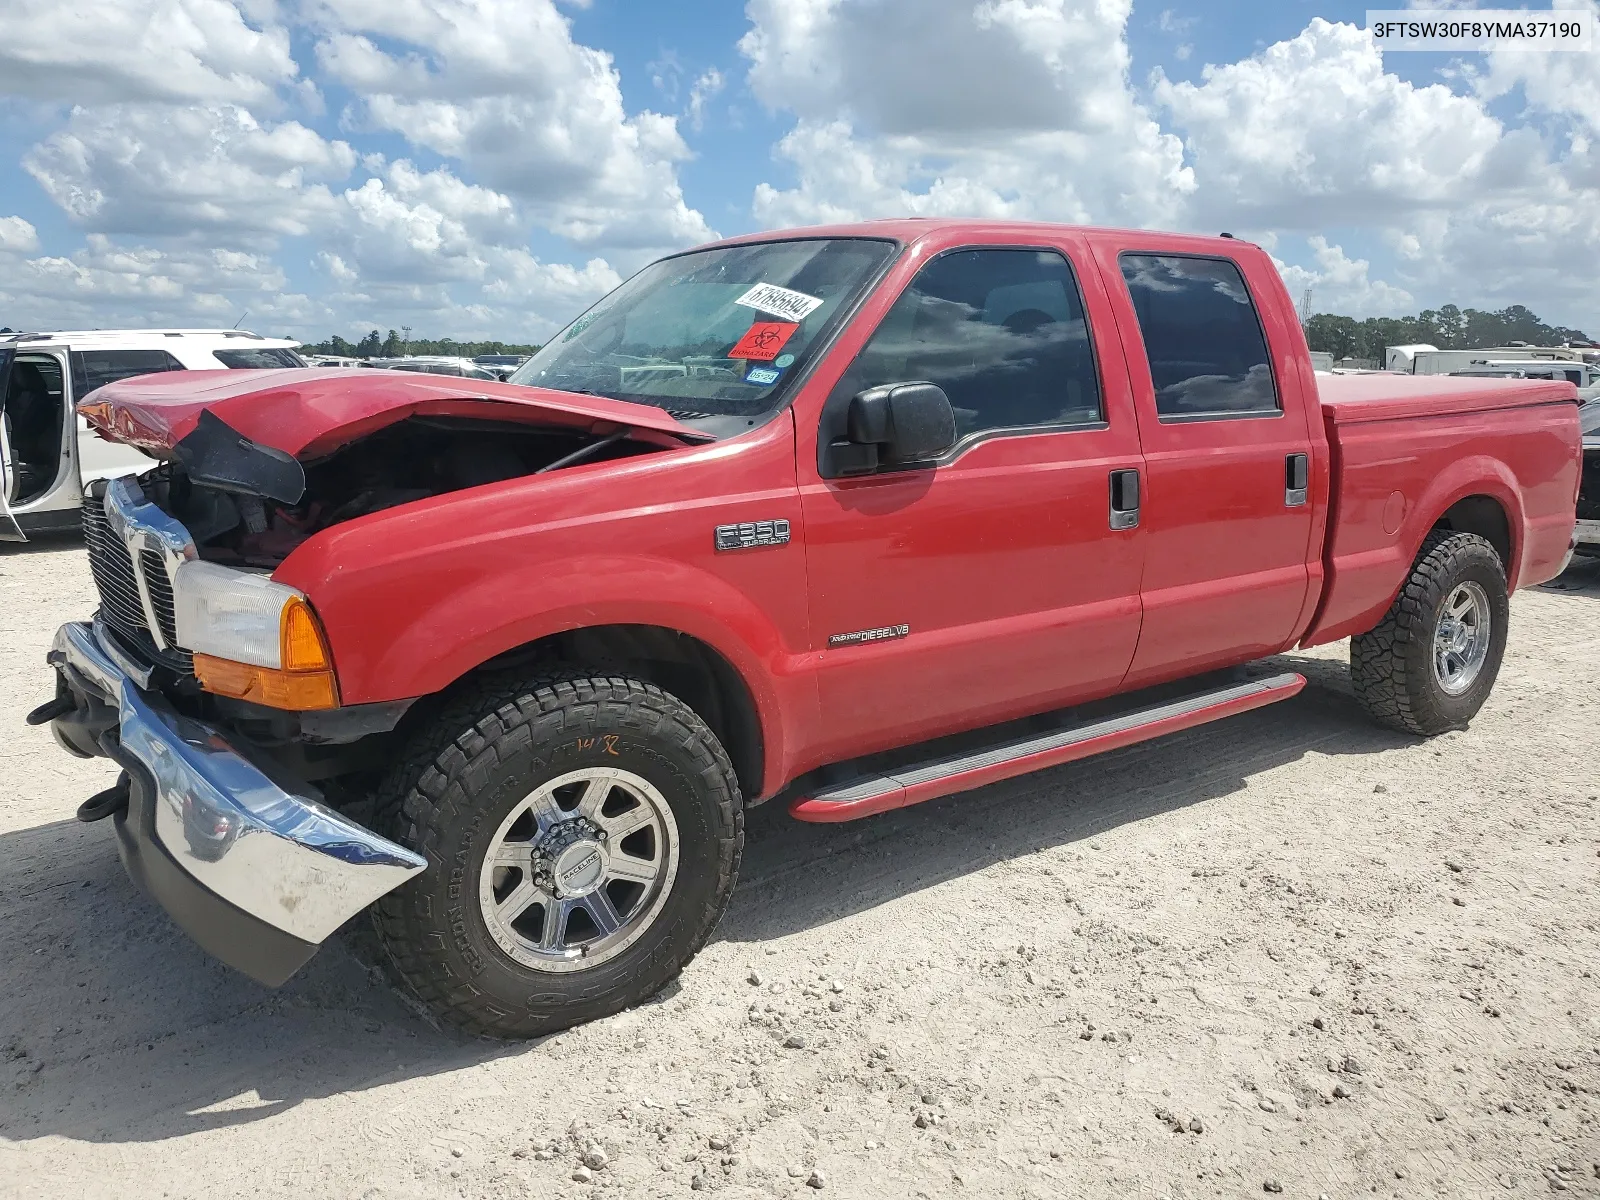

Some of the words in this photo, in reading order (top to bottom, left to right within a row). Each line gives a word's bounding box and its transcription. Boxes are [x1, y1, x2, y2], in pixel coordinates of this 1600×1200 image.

[731, 349, 776, 358] BIOHAZARD
[861, 627, 896, 641] DIESEL
[895, 624, 909, 636] V8
[563, 853, 599, 882] RACELINE
